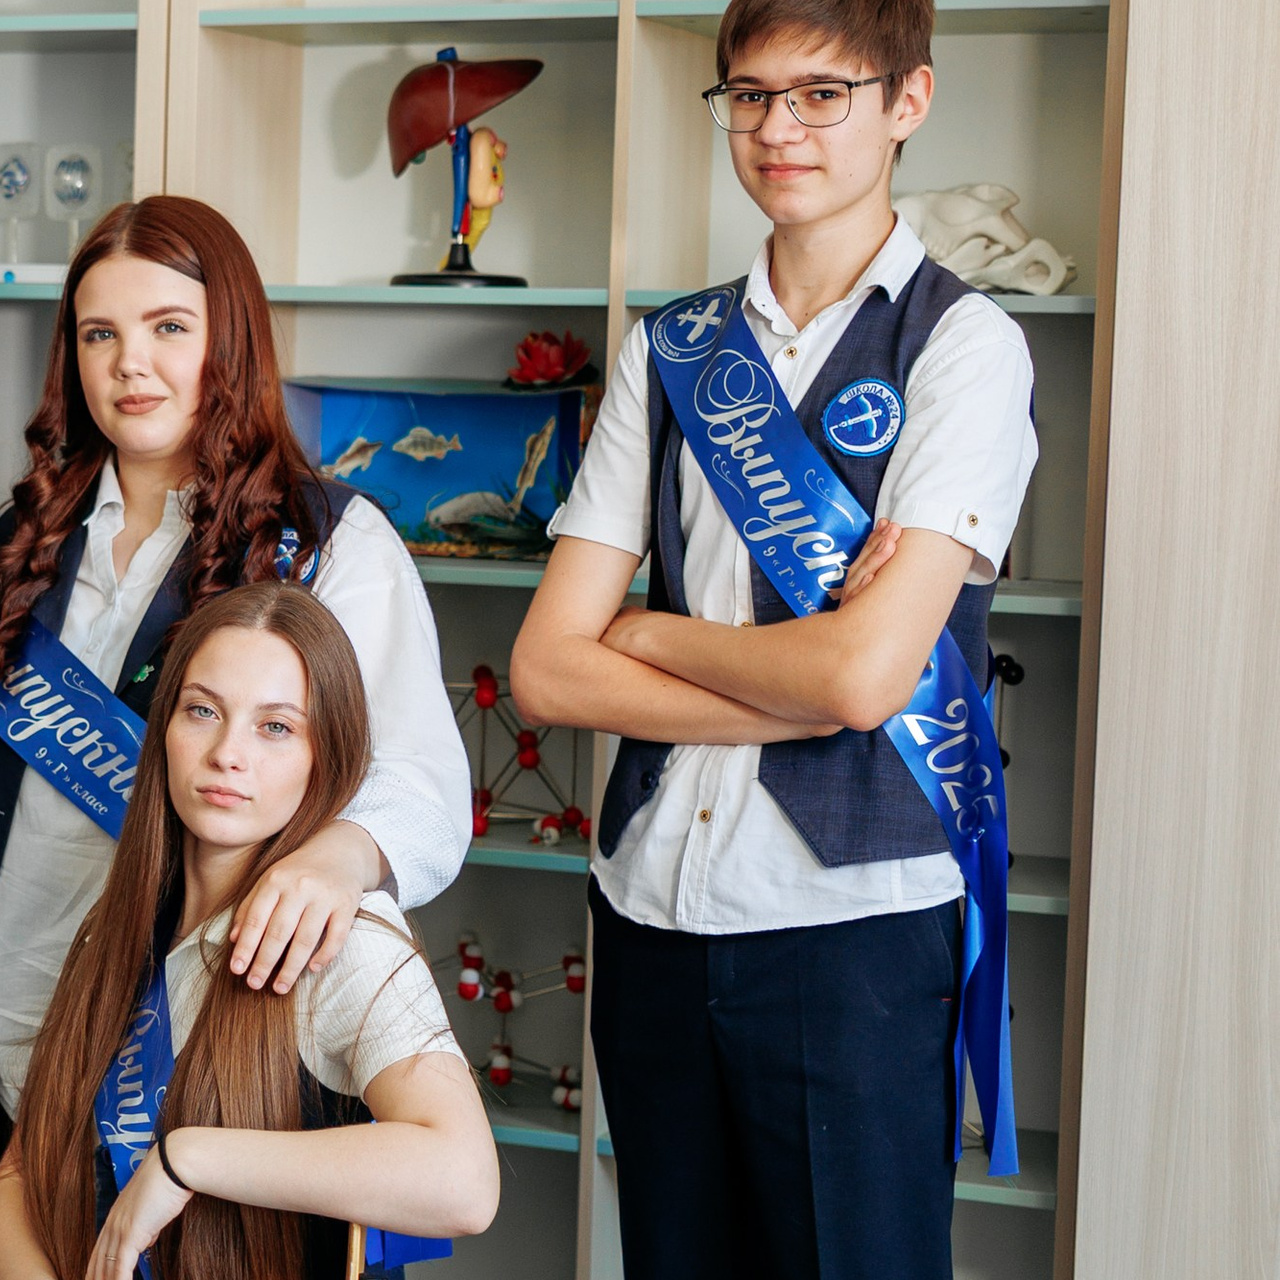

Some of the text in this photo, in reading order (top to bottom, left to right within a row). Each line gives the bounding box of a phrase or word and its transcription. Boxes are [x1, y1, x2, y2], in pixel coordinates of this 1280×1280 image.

[845, 385, 899, 419] ШКОЛА №24
[763, 546, 776, 556] 9
[3, 664, 138, 803] пускн
[901, 698, 999, 836] 2025
[35, 747, 48, 759] 9
[71, 782, 108, 815] класс
